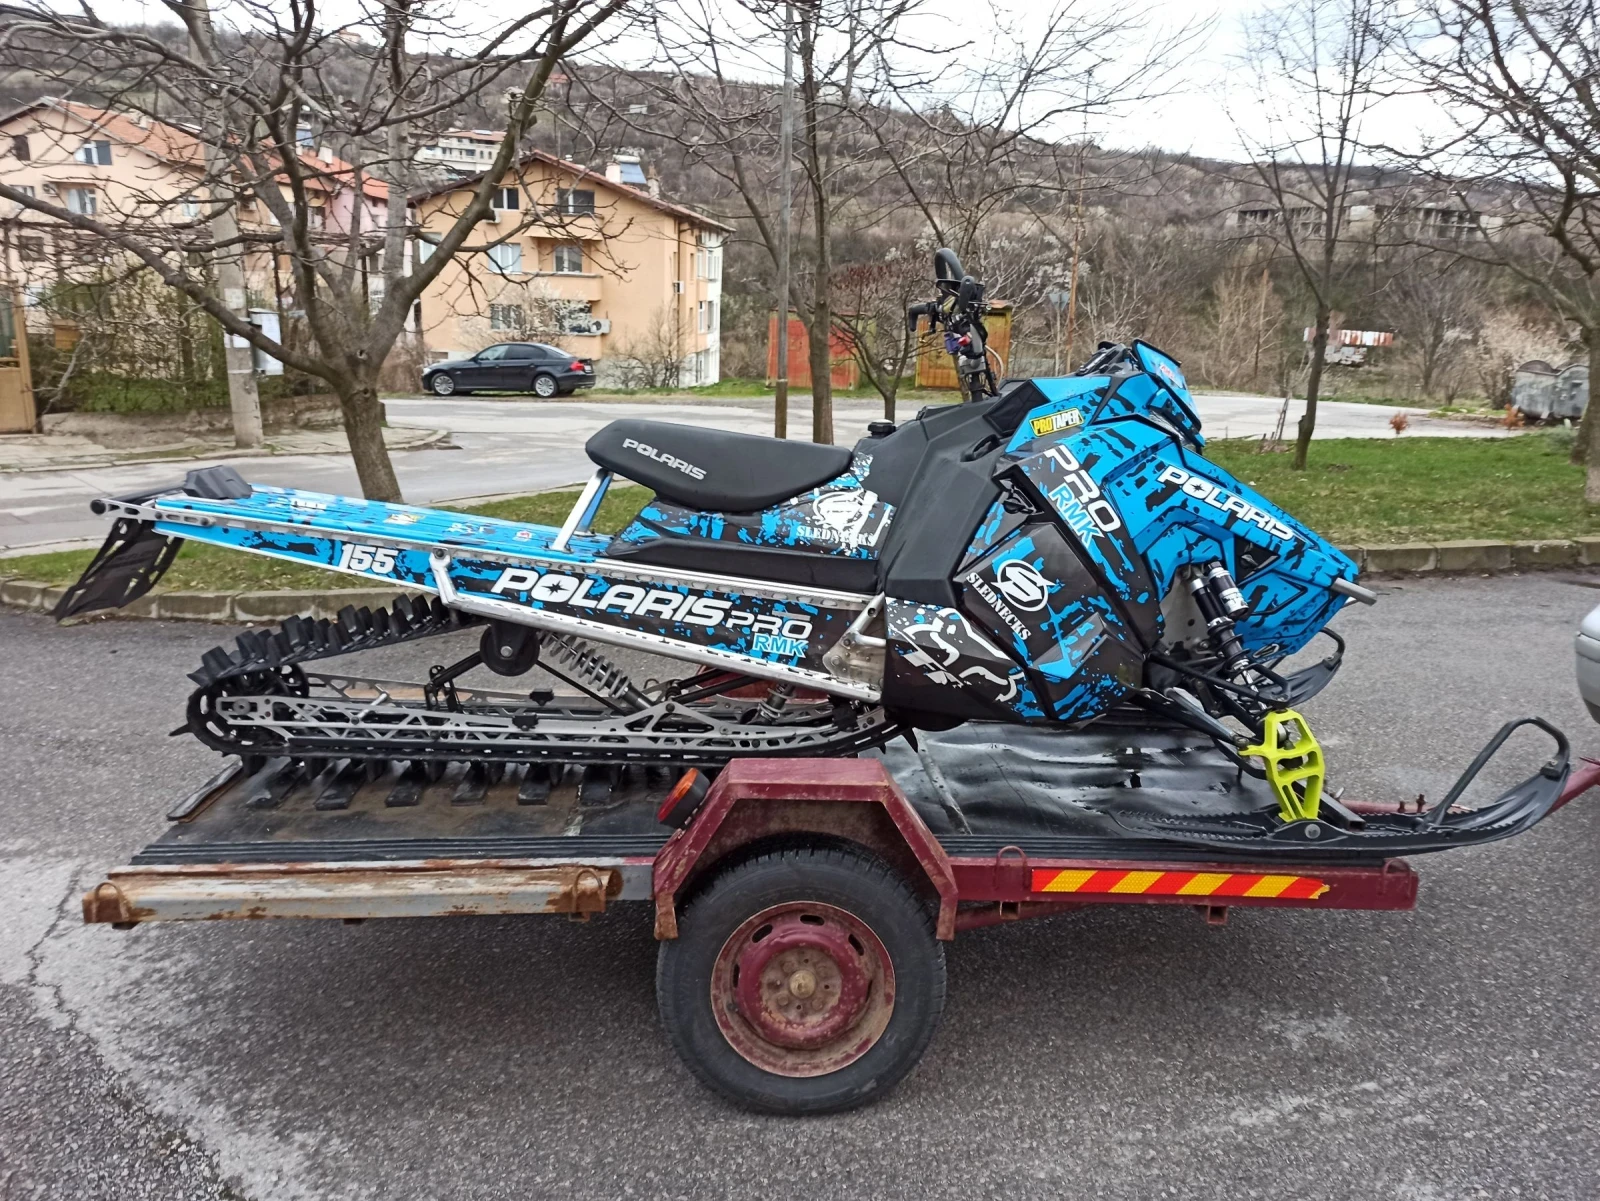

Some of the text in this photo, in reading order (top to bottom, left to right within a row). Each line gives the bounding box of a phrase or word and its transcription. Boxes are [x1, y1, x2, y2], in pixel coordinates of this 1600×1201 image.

[622, 438, 707, 480] POLARIS
[1043, 444, 1121, 532] PRO
[1048, 482, 1105, 549] RMK
[337, 543, 400, 574] 155
[490, 567, 813, 639] POLARIS PRO
[965, 572, 1032, 641] SLEDNECKS
[751, 633, 809, 657] RMK
